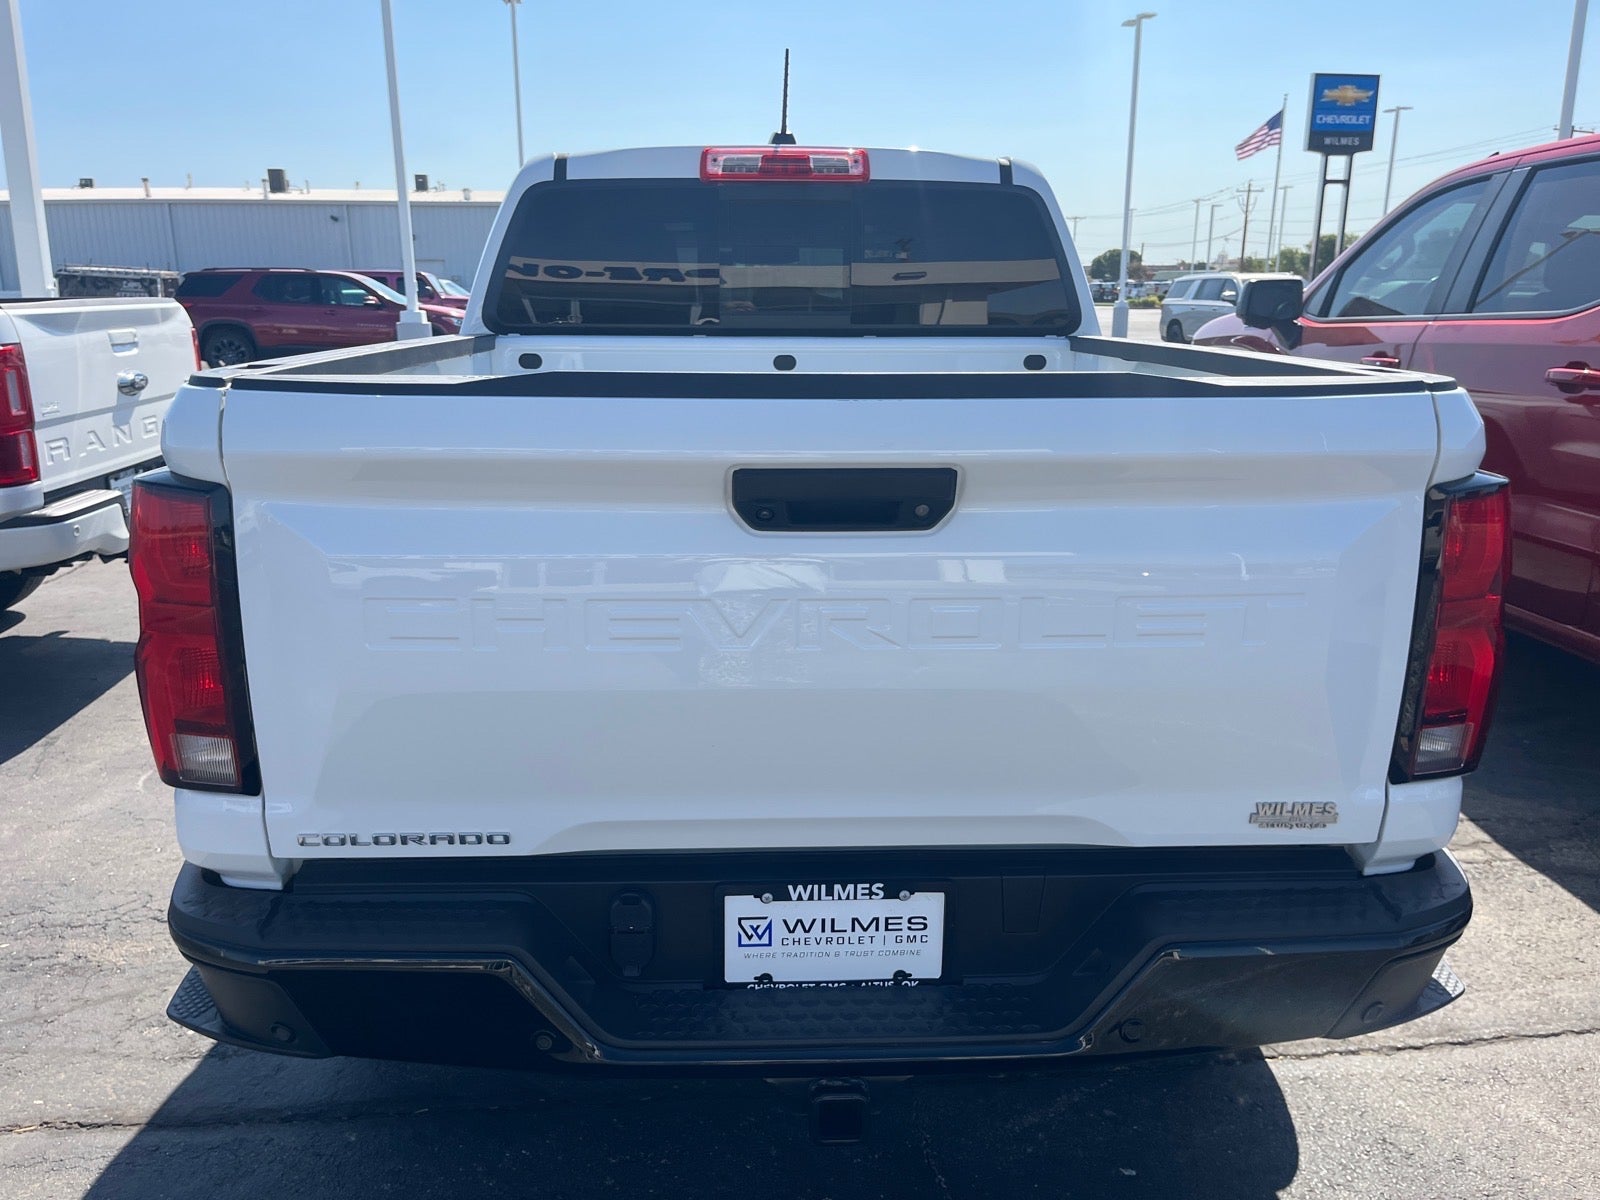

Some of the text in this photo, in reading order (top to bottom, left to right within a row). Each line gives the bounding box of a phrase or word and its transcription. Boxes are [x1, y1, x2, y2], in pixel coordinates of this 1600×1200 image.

[1316, 114, 1371, 125] CHEVROLET
[1323, 136, 1360, 146] WILMES
[362, 592, 1307, 652] CHEVROLET
[1255, 801, 1337, 817] WILMES
[297, 831, 511, 847] COLORADO
[788, 883, 885, 901] WILMES
[782, 915, 929, 934] WILMES
[781, 934, 929, 946] CHEVROLET GMC
[744, 951, 778, 959] WHERE
[781, 951, 831, 959] TRADITION
[844, 950, 875, 958] TRUST
[878, 949, 922, 957] COMBINE
